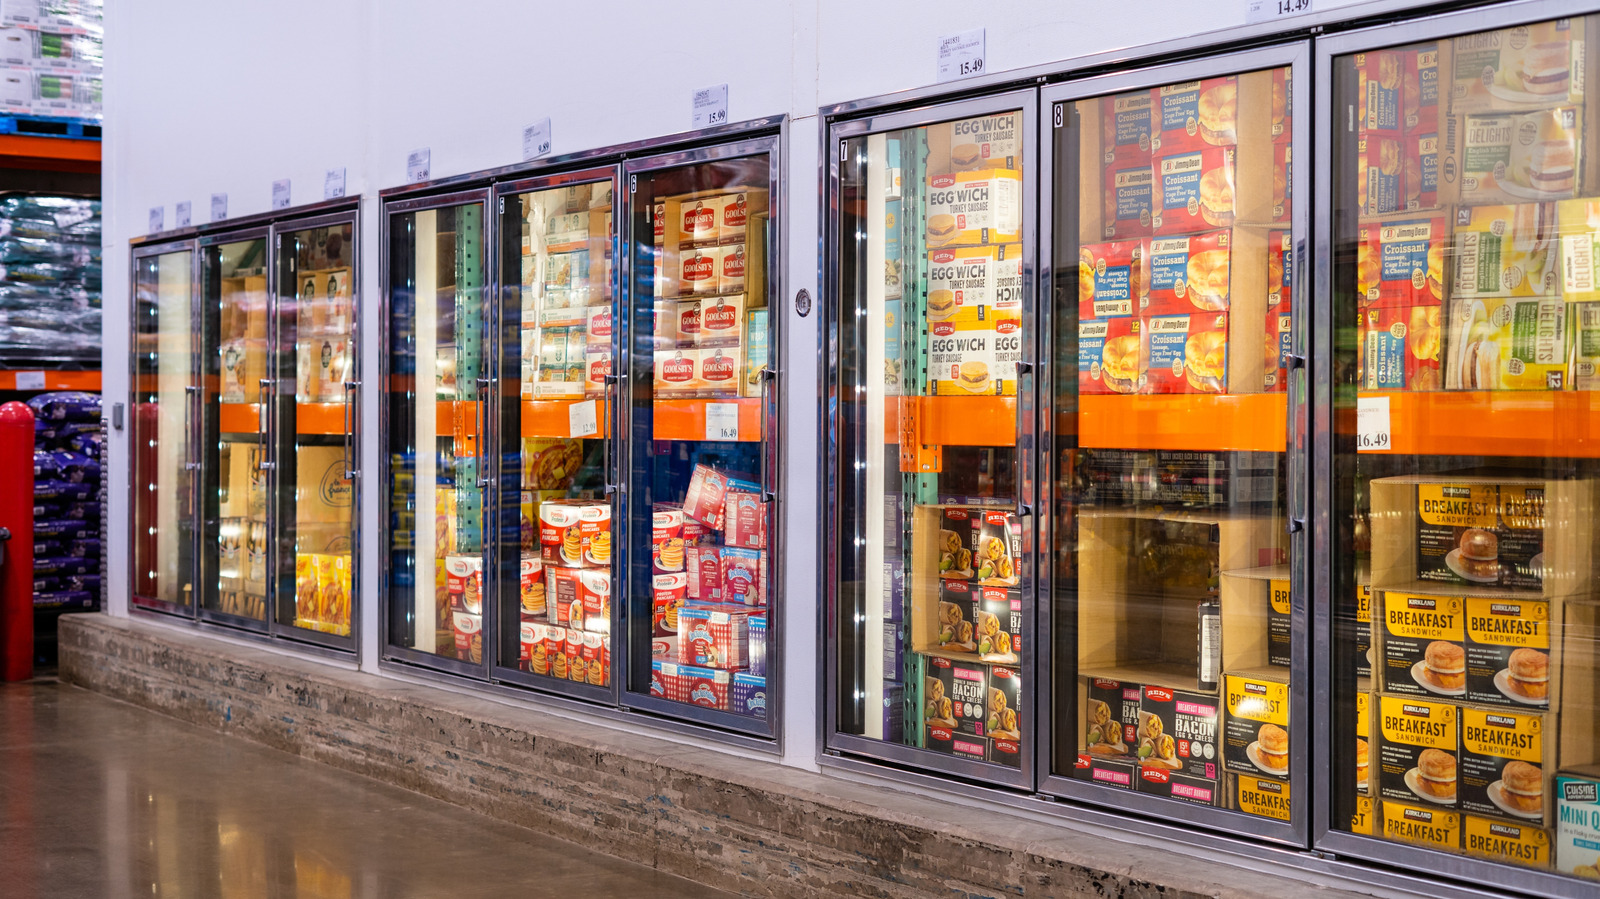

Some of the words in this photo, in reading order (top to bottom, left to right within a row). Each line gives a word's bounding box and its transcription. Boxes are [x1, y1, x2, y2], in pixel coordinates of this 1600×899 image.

[1278, 0, 1309, 15] 14.49
[1356, 54, 1366, 63] 12
[959, 58, 983, 75] 15.49
[1163, 94, 1197, 107] Croissant
[708, 110, 726, 123] 15.99
[1055, 105, 1062, 126] 8
[1562, 112, 1574, 122] 12
[974, 132, 992, 143] TURKEY
[993, 130, 1014, 141] SAUSAGE
[1469, 127, 1512, 143] DELIGHTS
[538, 141, 550, 154] 9.89
[1358, 140, 1367, 149] 12
[841, 141, 847, 160] 7
[631, 175, 636, 192] 6
[932, 177, 954, 186] RED'S
[1165, 174, 1198, 186] Croissant
[950, 204, 967, 214] TURKEY
[967, 202, 988, 212] SAUSAGE
[685, 213, 714, 225] GOOLSBY'S
[1458, 209, 1465, 224] 12
[1218, 234, 1228, 243] 12
[1360, 230, 1368, 238] 12
[1384, 243, 1425, 254] Croissant
[934, 253, 954, 261] RED'S
[1152, 255, 1185, 266] Croissant
[1461, 233, 1477, 290] DELIGHTS
[684, 262, 713, 272] GOOLSBY'S
[1412, 260, 1423, 268] Egg
[1575, 237, 1589, 289] DELIGHTS
[949, 280, 965, 290] TURKEY
[966, 278, 985, 289] SAUSAGE
[1096, 288, 1128, 298] Croissant
[705, 311, 735, 322] GOOLSBY'S
[1369, 310, 1377, 322] 12
[935, 326, 954, 334] RED'S
[997, 323, 1018, 331] RED'S
[1131, 321, 1139, 329] 12
[1538, 304, 1556, 361] DELIGHTS
[1151, 334, 1184, 344] Croissant
[932, 354, 946, 363] TURKEY
[946, 352, 962, 362] SAUSAGE
[995, 352, 1009, 362] TURKEY
[1379, 335, 1387, 384] Croissant
[664, 363, 693, 373] GOOLSBY'S
[703, 362, 733, 372] GOOLSBY'S
[1551, 373, 1561, 388] 12
[720, 428, 737, 438] 16.49
[1357, 432, 1388, 447] 16.49
[1424, 499, 1488, 517] BREAKFAST
[1436, 515, 1477, 524] SANDWICH
[947, 582, 967, 591] RED'S
[984, 590, 1005, 599] RED'S
[1408, 599, 1436, 607] KIRKLAND
[1491, 604, 1521, 613] KIRKLAND
[1390, 610, 1454, 628] BREAKFAST
[1401, 626, 1442, 637] SANDWICH
[1471, 616, 1539, 636] BREAKFAST
[1483, 633, 1527, 644] SANDWICH
[994, 667, 1014, 677] RED'S
[953, 682, 983, 699] BACON
[1245, 683, 1267, 692] KIRKLAND
[1147, 690, 1171, 700] RED'S
[1177, 702, 1198, 713] BREAKFAST
[1403, 705, 1430, 715] KIRKLAND
[1486, 715, 1516, 725] KIRKLAND
[1175, 718, 1215, 737] BACON
[1385, 715, 1447, 738] BREAKFAST
[932, 730, 951, 739] RED'S
[1194, 734, 1215, 743] CHEESE
[1395, 733, 1436, 745] SANDWICH
[1467, 726, 1534, 749] BREAKFAST
[997, 742, 1017, 752] RED'S
[1478, 744, 1521, 757] SANDWICH
[1094, 769, 1113, 780] BREAKFAST
[1113, 773, 1129, 783] BURRITO
[1143, 770, 1168, 781] RED'S
[1257, 781, 1281, 791] KIRKLAND
[1566, 784, 1595, 795] CUISINE
[1173, 785, 1194, 795] BREAKFAST
[1193, 789, 1210, 799] BURRITO
[1252, 806, 1289, 819] SANDWICH
[1404, 809, 1432, 820] KIRKLAND
[1560, 804, 1588, 826] MINI
[1387, 818, 1450, 844] BREAKFAST
[1490, 824, 1521, 836] KIRKLAND
[1573, 829, 1587, 839] flaky
[1470, 834, 1540, 861] BREAKFAST
